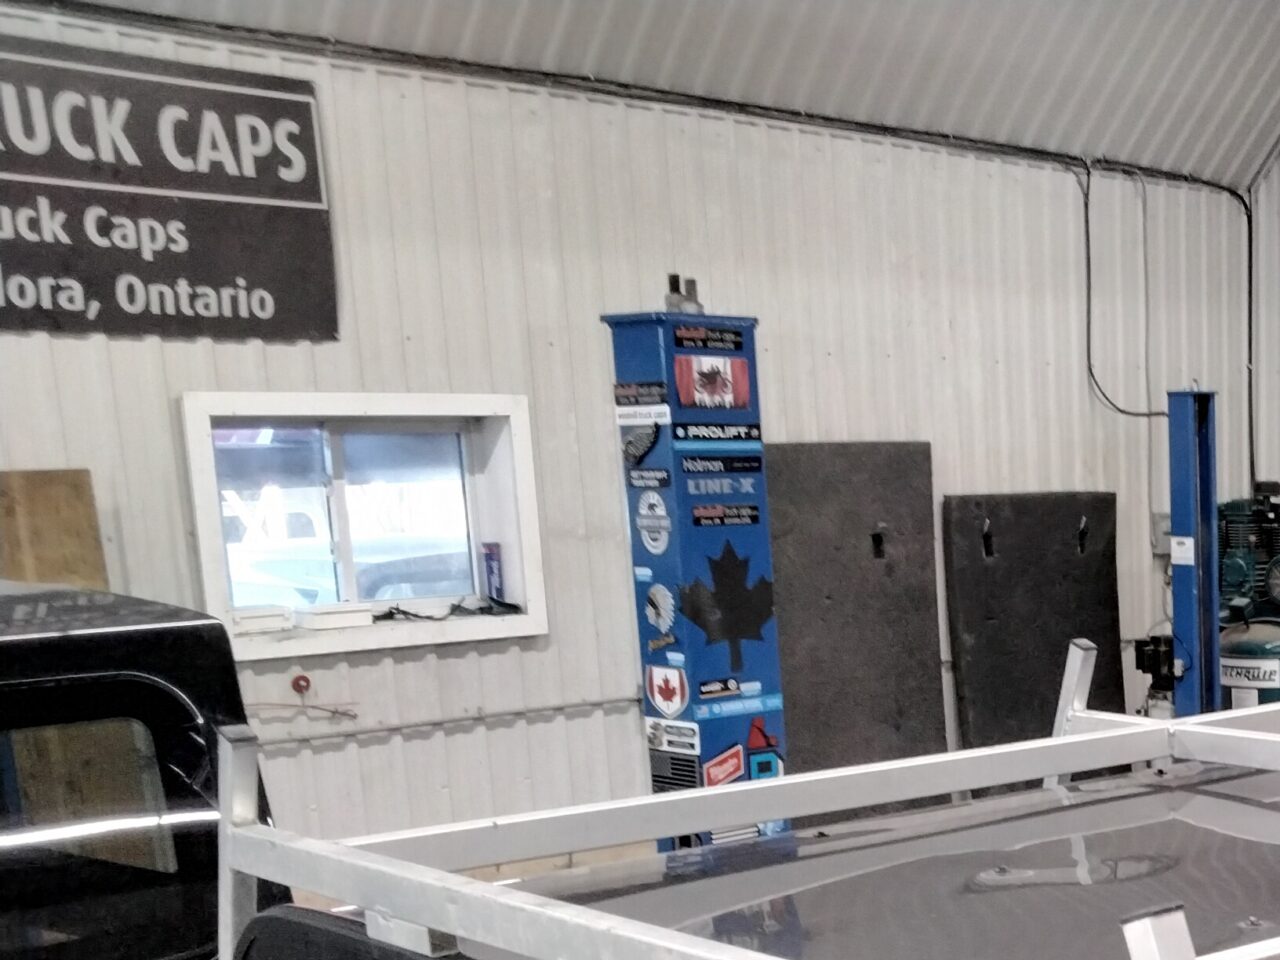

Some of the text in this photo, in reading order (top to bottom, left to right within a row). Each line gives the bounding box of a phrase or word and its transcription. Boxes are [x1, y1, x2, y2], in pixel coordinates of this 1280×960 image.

[0, 80, 307, 183] UCK CAPS
[83, 205, 189, 262] Caps
[115, 273, 276, 320] Ontario
